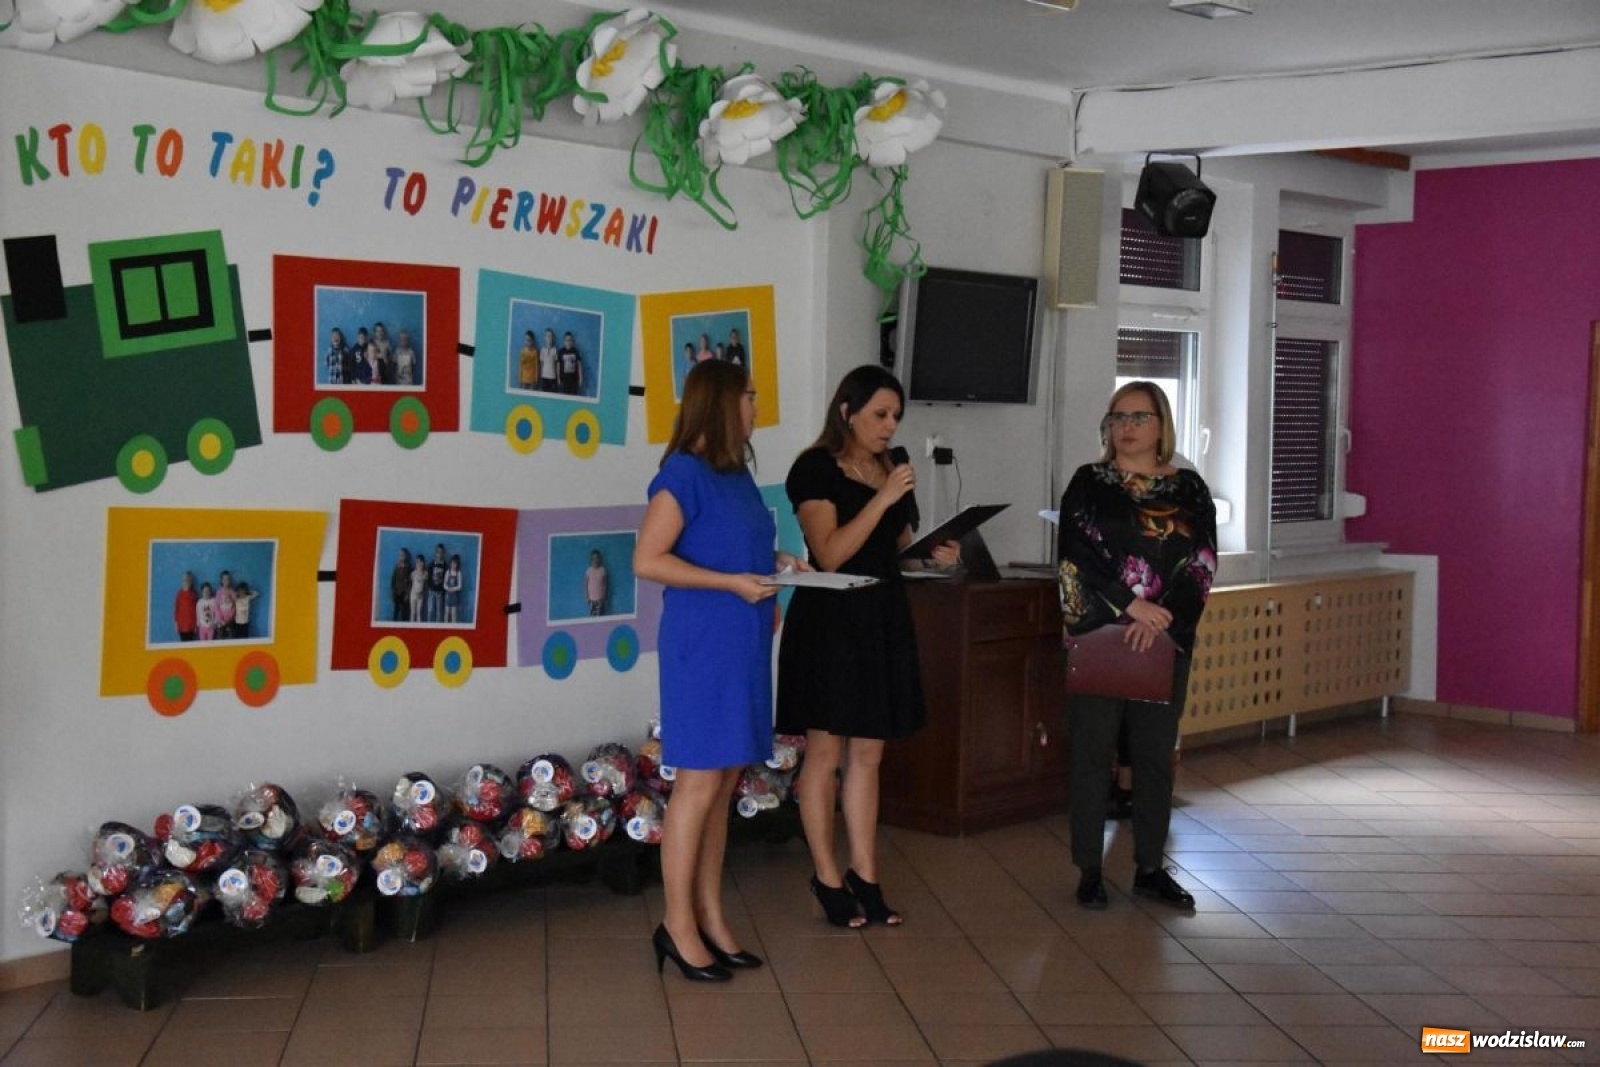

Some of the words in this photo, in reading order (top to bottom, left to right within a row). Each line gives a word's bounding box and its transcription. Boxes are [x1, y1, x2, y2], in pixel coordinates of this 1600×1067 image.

[15, 122, 107, 186] KTO
[132, 124, 184, 178] TO
[209, 131, 336, 207] TAKI?
[384, 167, 427, 216] TO
[451, 176, 658, 254] PIERWSZAKI
